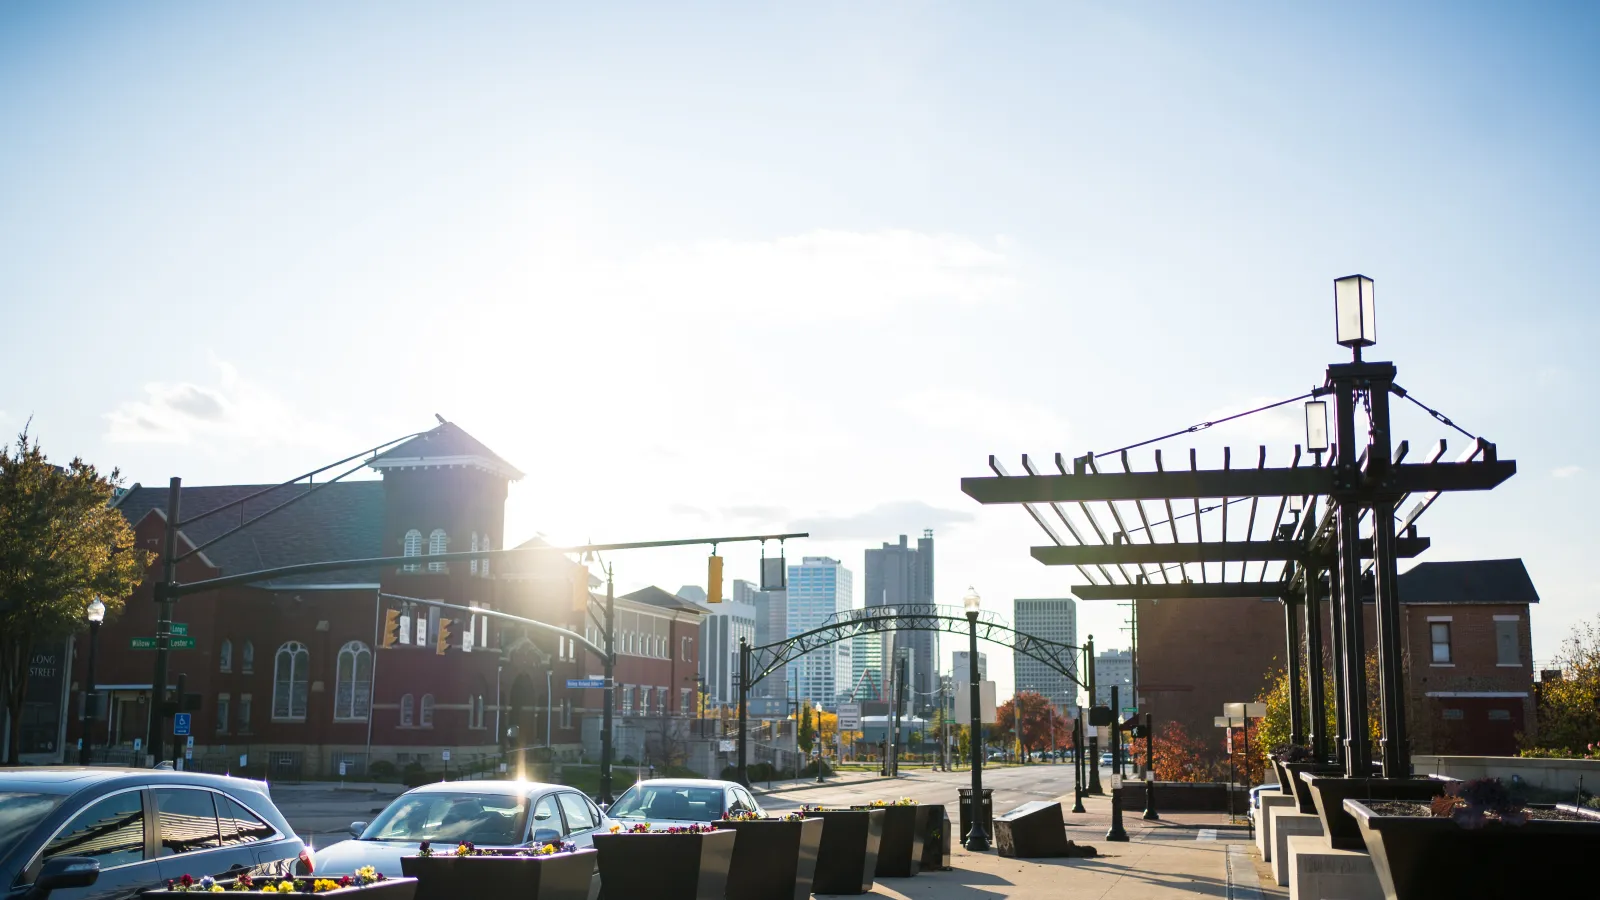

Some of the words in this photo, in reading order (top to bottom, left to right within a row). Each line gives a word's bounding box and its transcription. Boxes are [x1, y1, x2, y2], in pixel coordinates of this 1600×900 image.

[172, 625, 183, 634] Long
[32, 654, 56, 665] LONG
[29, 667, 57, 677] STREET
